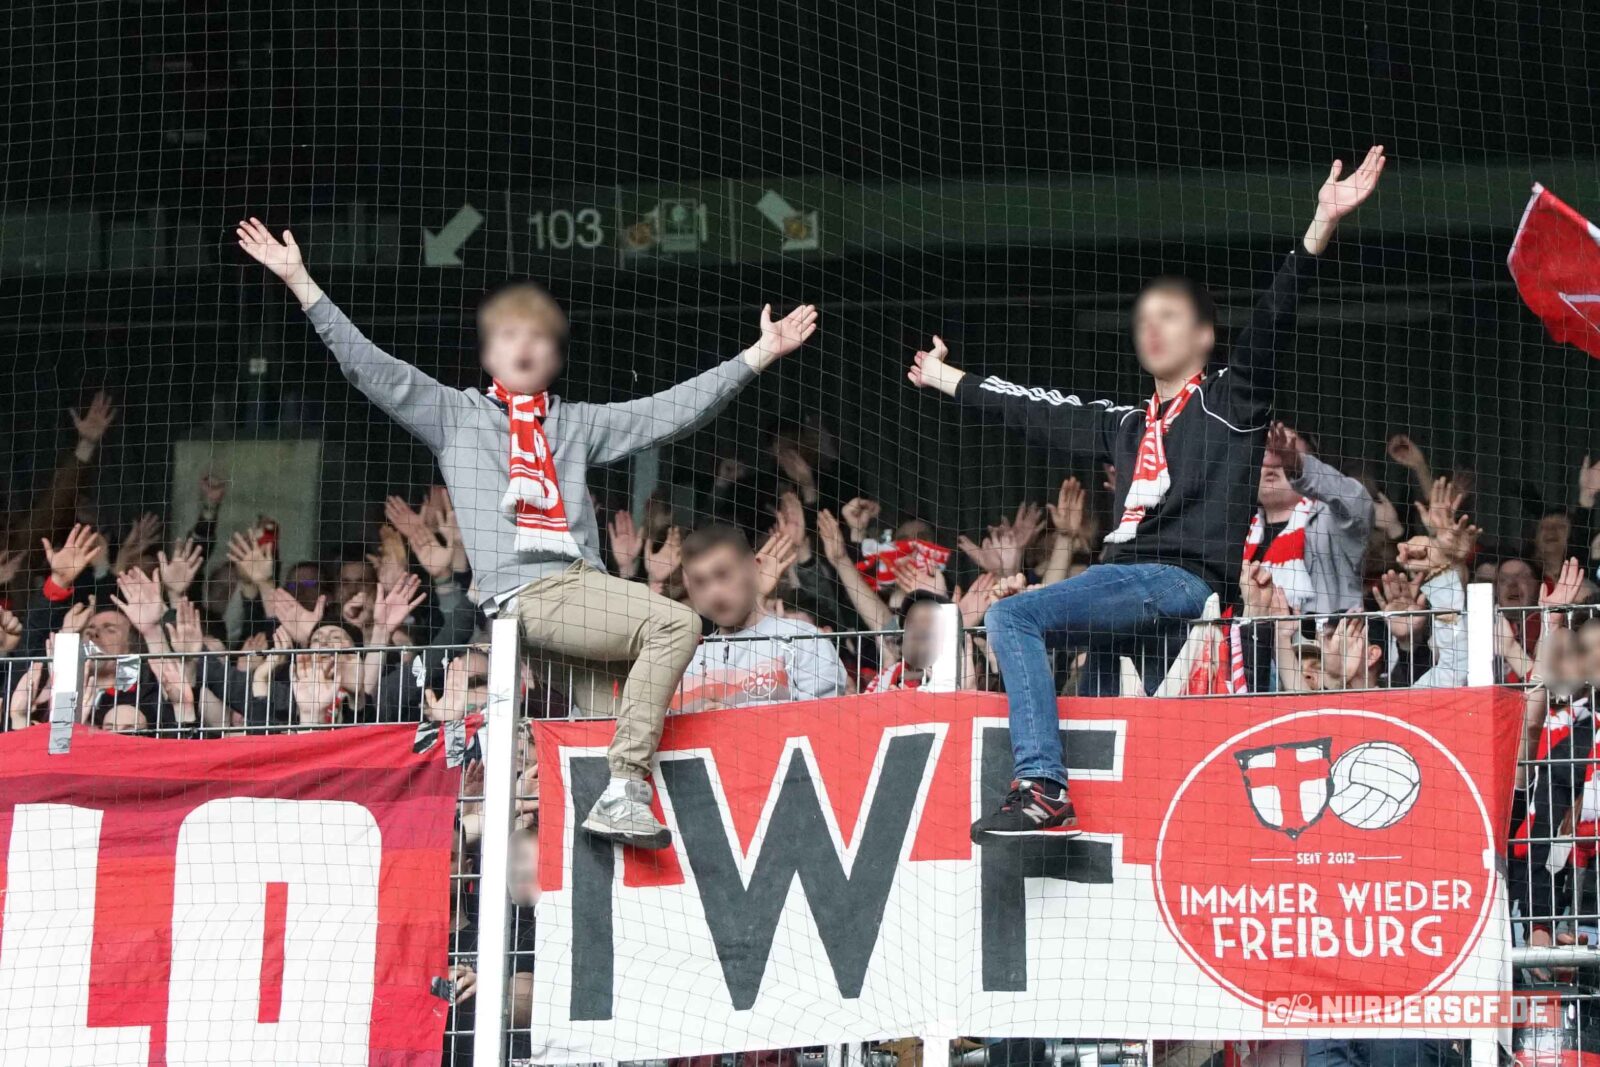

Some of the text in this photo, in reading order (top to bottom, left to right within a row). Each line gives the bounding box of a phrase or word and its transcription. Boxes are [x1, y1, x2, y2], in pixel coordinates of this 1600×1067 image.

[526, 207, 604, 250] 103
[568, 725, 1117, 1021] IWF
[1296, 852, 1356, 865] SEIT 2012
[1179, 878, 1473, 916] IMMMER WIEDER
[1212, 915, 1444, 961] FREIBURG
